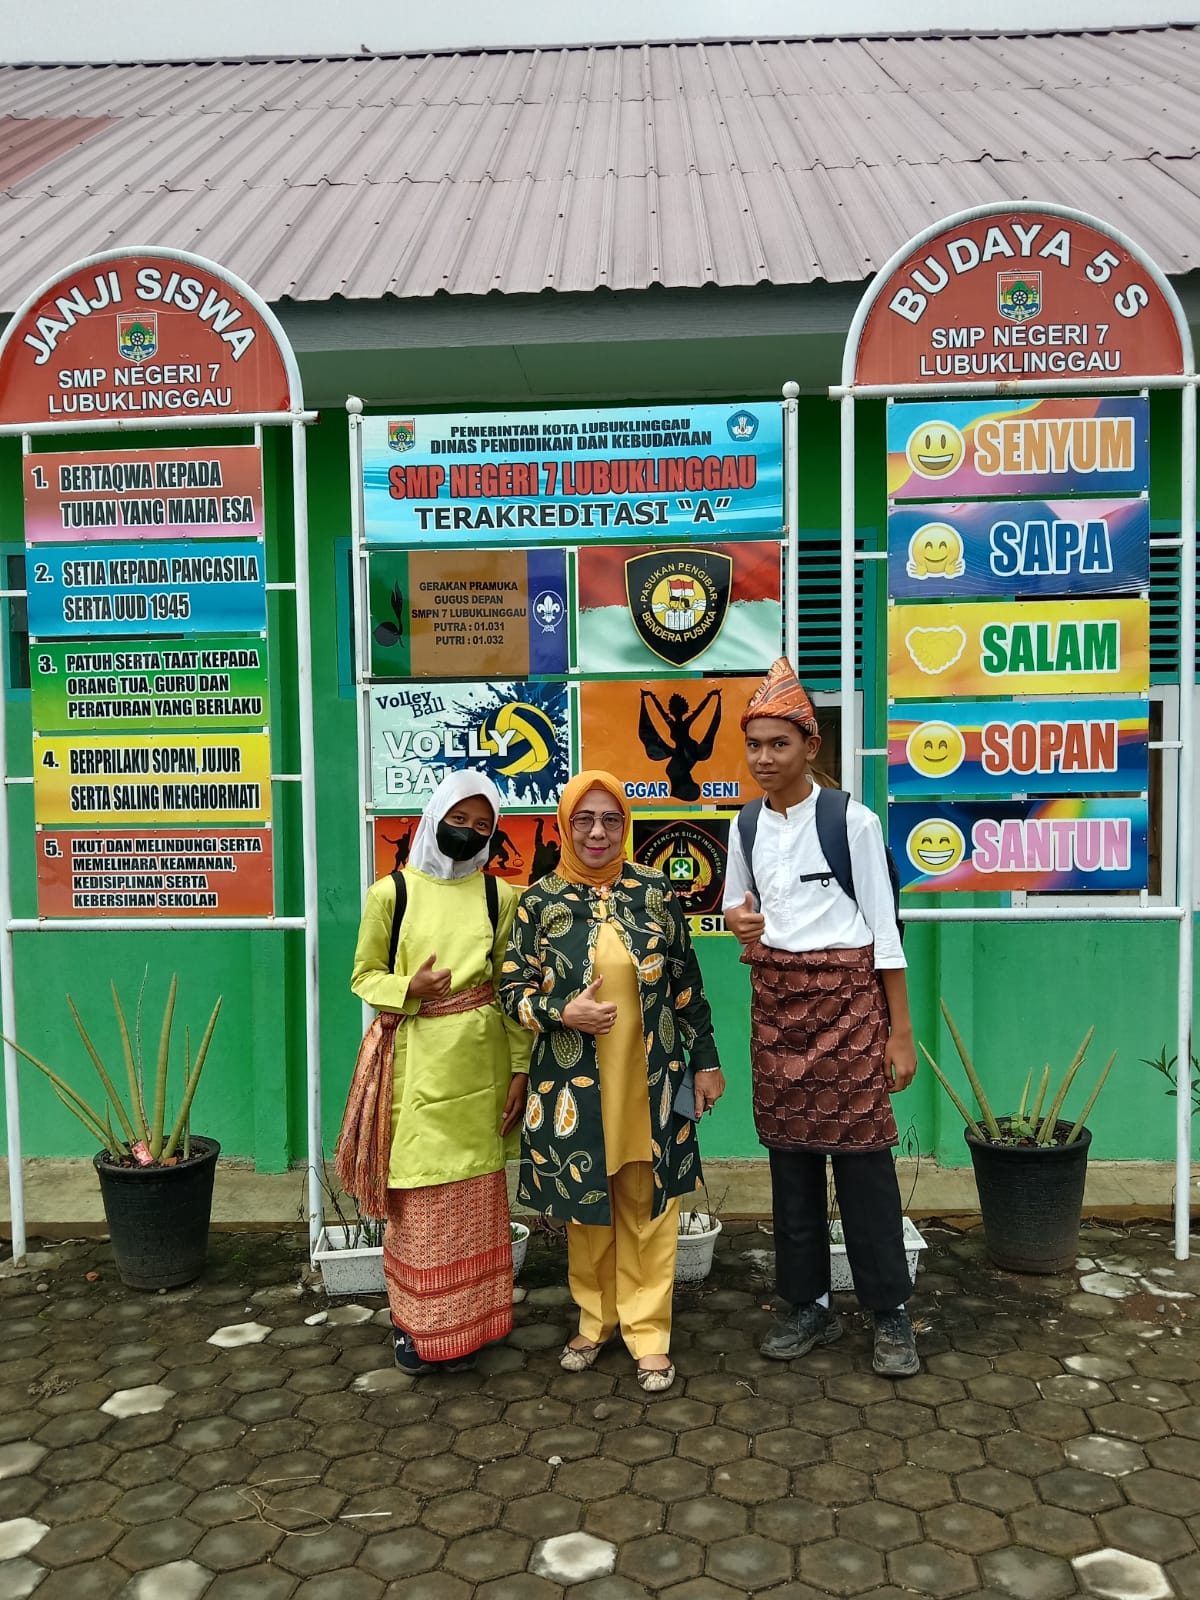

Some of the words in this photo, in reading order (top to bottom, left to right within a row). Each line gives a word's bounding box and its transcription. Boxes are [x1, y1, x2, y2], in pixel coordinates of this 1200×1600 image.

[889, 224, 1071, 324] BUDAYA
[1086, 250, 1120, 284] 5
[1115, 284, 1149, 318] S
[23, 271, 122, 365] JANJI
[136, 268, 256, 361] SISWA
[931, 327, 985, 348] SMP
[993, 325, 1087, 346] NEGERI
[1097, 324, 1109, 344] 7
[920, 351, 1120, 376] LUBUKLINGGAU
[58, 369, 107, 389] SMP
[114, 364, 200, 386] NEGERI
[208, 364, 220, 382] 7
[49, 388, 232, 413] LUBUKLINGGAU
[451, 425, 539, 437] PEMERINTAH
[542, 424, 578, 435] KOTA
[582, 419, 691, 433] LUBUKLINGGAU
[431, 439, 477, 454] DINAS
[481, 437, 572, 452] PENDIDIKAN
[577, 436, 608, 449] DAN
[612, 432, 712, 448] KEBUDAYAAN
[977, 419, 1132, 473] SENYUM
[33, 467, 47, 487] 1.
[61, 464, 151, 492] BERTAQWA
[156, 462, 221, 488] KEPADA
[389, 465, 445, 499] SMP
[450, 463, 539, 498] NEGERI
[543, 462, 558, 495] 7
[562, 455, 757, 495] LUBUKLINGGAU
[62, 501, 116, 527] TUHAN
[121, 500, 164, 525] YANG
[169, 499, 219, 523] MAHA
[222, 498, 253, 522] ESA
[415, 502, 669, 530] TERAKREDITASI
[993, 521, 1110, 573] SAPA
[36, 564, 53, 581] 2.
[63, 561, 106, 585] SETIA
[111, 559, 168, 584] KEPADA
[173, 557, 258, 582] PANCASILA
[640, 563, 675, 602] PASUKAN
[679, 562, 718, 600] PENGIBAR
[420, 582, 466, 591] GERAKAN
[469, 582, 518, 590] PRAMUKA
[65, 597, 111, 620] SERTA
[116, 596, 147, 619] UUD
[150, 595, 189, 618] 1945
[435, 596, 469, 604] GUGUS
[472, 596, 503, 604] DEPAN
[412, 609, 439, 618] SMPN
[442, 609, 447, 617] 7
[450, 609, 526, 617] LUBUKLINGGAU
[642, 612, 682, 642] BENDERA
[684, 610, 717, 642] PUSAKA
[434, 623, 467, 631] PUTRA
[475, 623, 504, 631] 01.031
[436, 637, 465, 645] PUTRI
[473, 636, 503, 644] 01.032
[983, 623, 1118, 673] SALAM
[40, 656, 56, 672] 3.
[67, 654, 111, 671] PATUH
[116, 654, 160, 669] SERTA
[163, 652, 197, 668] TAAT
[202, 651, 258, 667] KEPADA
[68, 678, 116, 694] ORANG
[120, 677, 151, 694] TUA,
[155, 676, 195, 692] GURU
[200, 675, 228, 690] DAN
[69, 701, 151, 717] PERATURAN
[155, 700, 192, 716] YANG
[197, 698, 261, 714] BERLAKU
[376, 691, 431, 710] Volley
[410, 697, 446, 718] Ball
[383, 729, 517, 759] VOLLY
[985, 723, 1115, 772] SOPAN
[43, 752, 59, 767] 4.
[71, 749, 149, 773] BERPRILAKU
[153, 748, 200, 774] SOPAN,
[202, 748, 240, 772] JUJUR
[71, 785, 110, 810] SERTA
[114, 785, 159, 809] SALING
[162, 784, 259, 809] MENGHORMATI
[625, 783, 668, 797] GGAR
[703, 783, 738, 796] SENI
[45, 841, 62, 856] 5.
[72, 840, 103, 852] IKUT
[107, 840, 132, 852] DAN
[135, 839, 216, 851] MELINDUNGI
[220, 839, 261, 851] SERTA
[653, 832, 679, 847] PENCAK
[682, 832, 701, 840] SILAT
[702, 839, 722, 873] INDONESIA
[975, 820, 1128, 871] SANTUN
[73, 858, 157, 871] MEMELIHARA
[161, 857, 235, 871] KEAMANAN,
[74, 876, 162, 889] KEDISIPLINAN
[167, 876, 206, 888] SERTA
[74, 894, 155, 907] KEBERSIHAN
[159, 893, 216, 906] SEKOLAH
